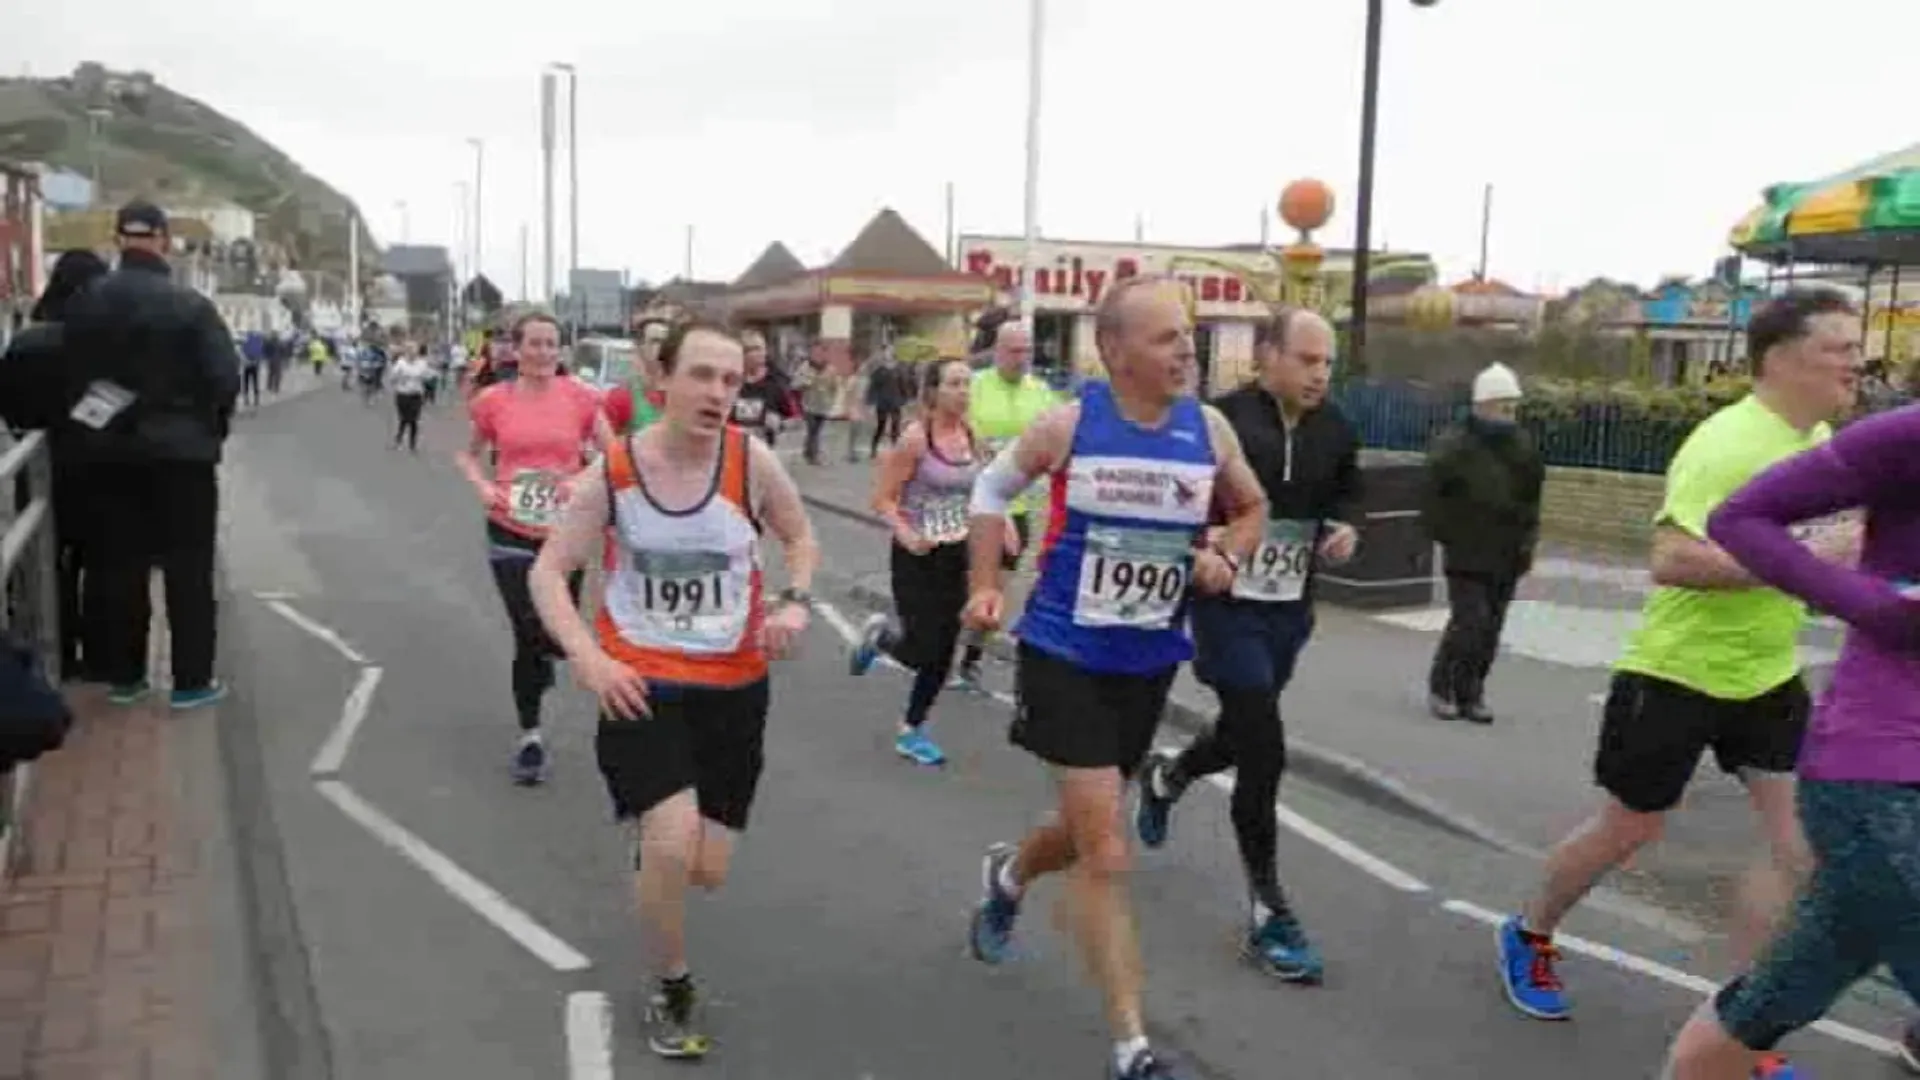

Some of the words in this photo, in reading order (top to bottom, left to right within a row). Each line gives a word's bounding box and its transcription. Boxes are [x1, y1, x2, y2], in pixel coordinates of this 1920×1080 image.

[1092, 557, 1181, 601] 1990
[1246, 544, 1309, 578] 1950
[644, 572, 722, 613] 1991
